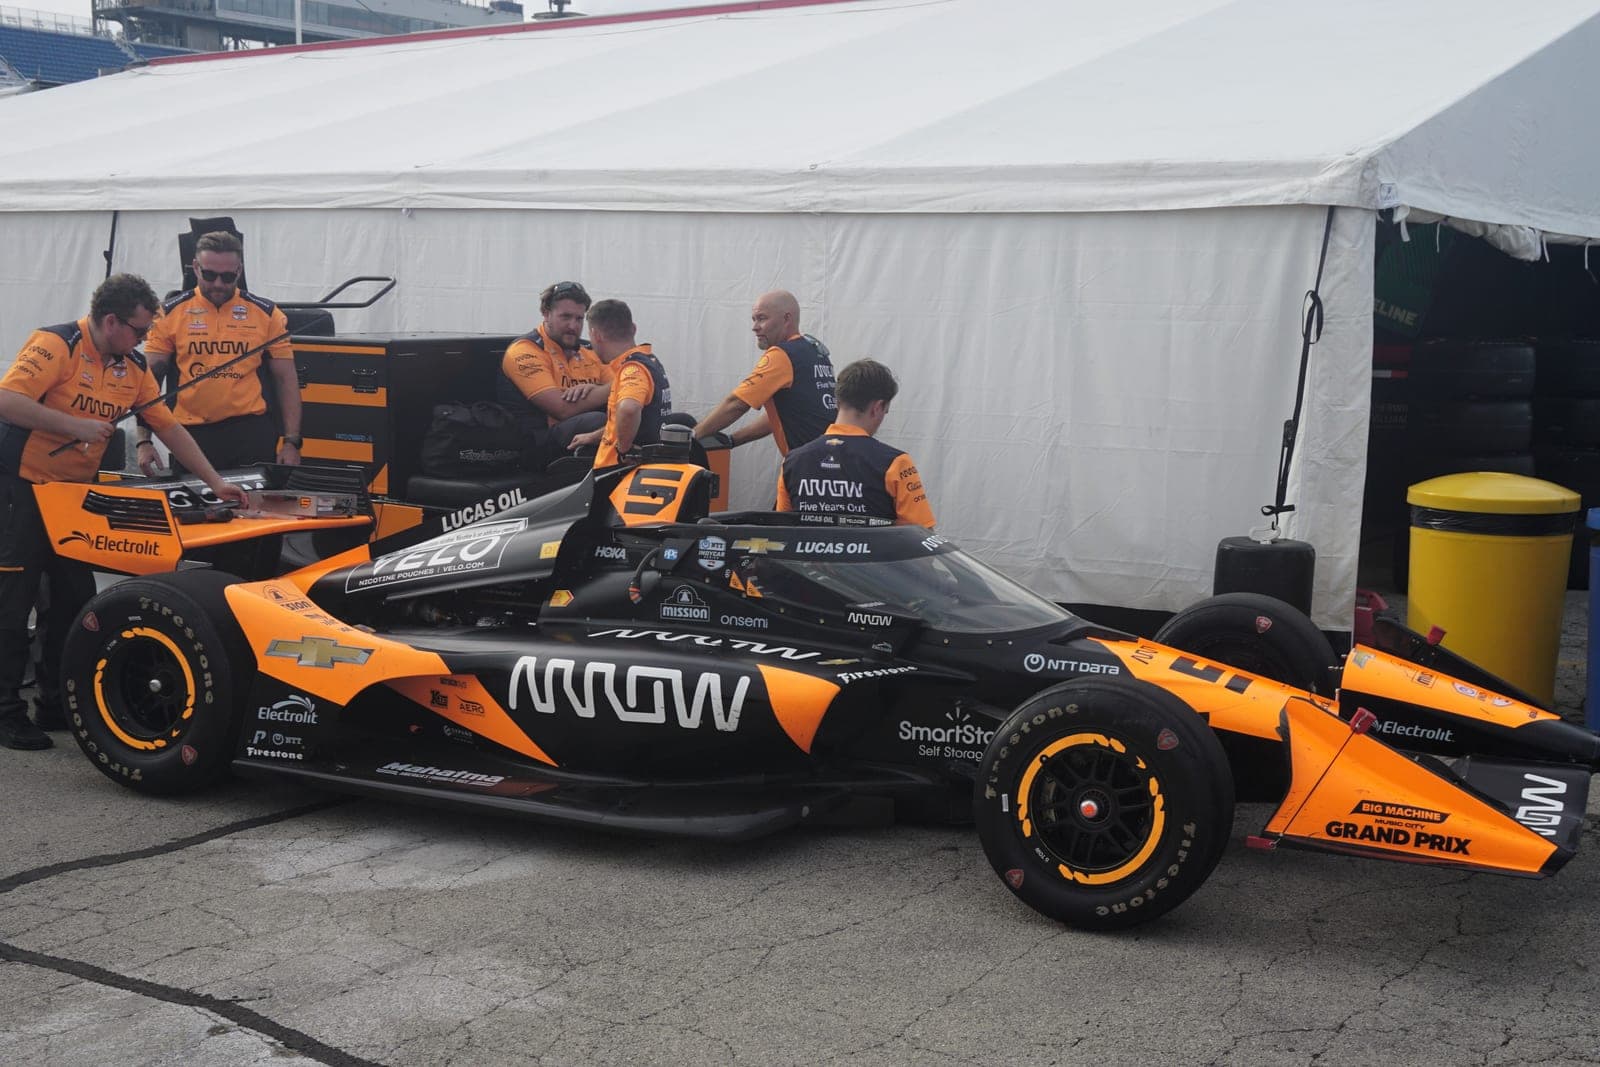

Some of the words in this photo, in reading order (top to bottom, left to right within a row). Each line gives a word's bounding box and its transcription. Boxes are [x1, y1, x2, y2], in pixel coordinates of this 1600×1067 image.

[188, 341, 249, 354] ARROW
[71, 394, 129, 419] ARROW
[624, 469, 684, 516] 5
[798, 479, 863, 498] ARROW
[441, 498, 495, 533] LUCAS
[498, 487, 527, 510] OIL
[799, 501, 818, 511] Five
[819, 502, 845, 512] Years
[847, 504, 867, 513] Out
[801, 515, 823, 523] LUCAS
[95, 535, 160, 556] Electrolit
[594, 546, 627, 560] HOKA
[698, 550, 725, 558] INDYCAR
[796, 542, 844, 554] LUCAS
[846, 542, 871, 554] OIL
[373, 536, 501, 575] VELO
[358, 574, 395, 586] NICOTINE
[397, 568, 434, 580] POUCHES
[443, 561, 485, 573] VELO.COM
[720, 613, 769, 629] onsemi
[847, 612, 893, 627] ARROW
[837, 665, 918, 684] Firestone
[508, 655, 751, 732] ARROW
[258, 706, 319, 725] Electrolit
[459, 702, 485, 714] AERO
[1382, 720, 1454, 742] Electrolit
[246, 746, 304, 760] Firestone
[918, 744, 941, 757] Self
[943, 746, 985, 762] Storag
[383, 761, 505, 784] Mahatma
[1362, 802, 1384, 815] BIG
[1385, 805, 1442, 822] MACHINE
[1374, 818, 1403, 828] MUSIC
[1404, 821, 1426, 830] CITY
[1325, 820, 1412, 846] GRAND
[1414, 832, 1472, 856] PRIX
